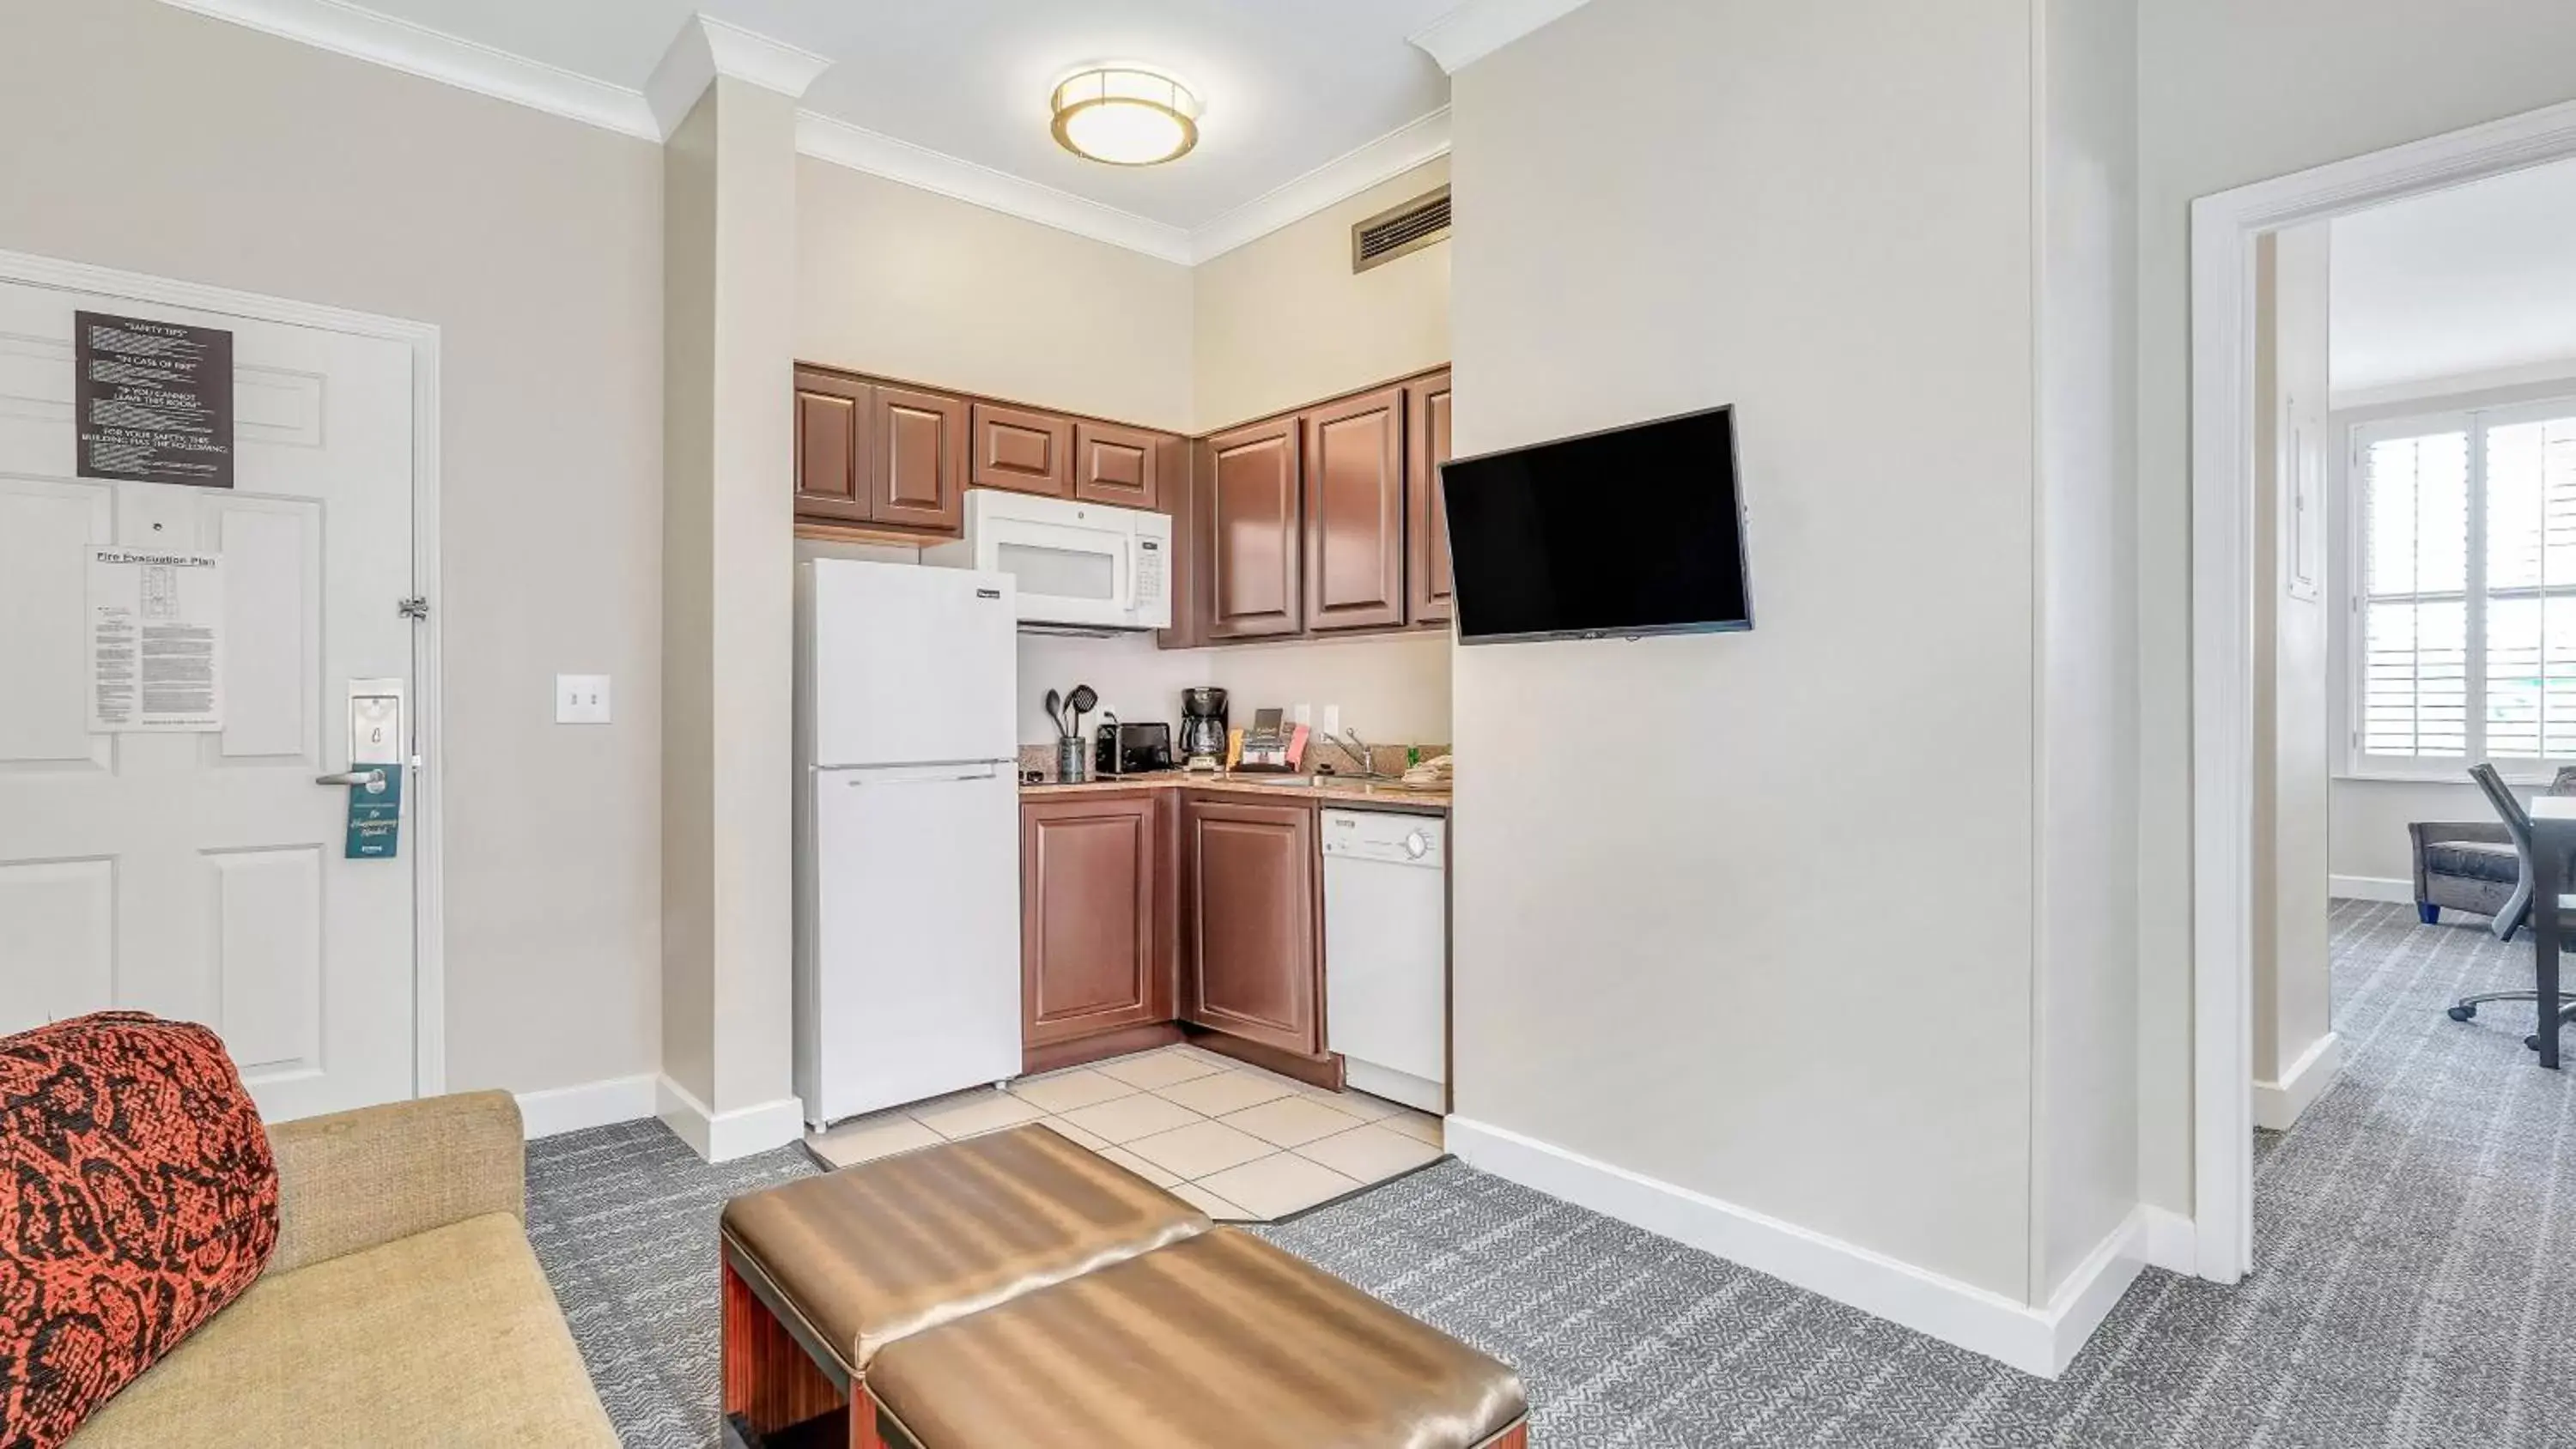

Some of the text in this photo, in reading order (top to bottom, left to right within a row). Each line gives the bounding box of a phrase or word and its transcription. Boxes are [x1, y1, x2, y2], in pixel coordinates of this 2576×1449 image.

[125, 430, 150, 440] YOUR
[97, 552, 216, 566] Fire Evacuation Plan
